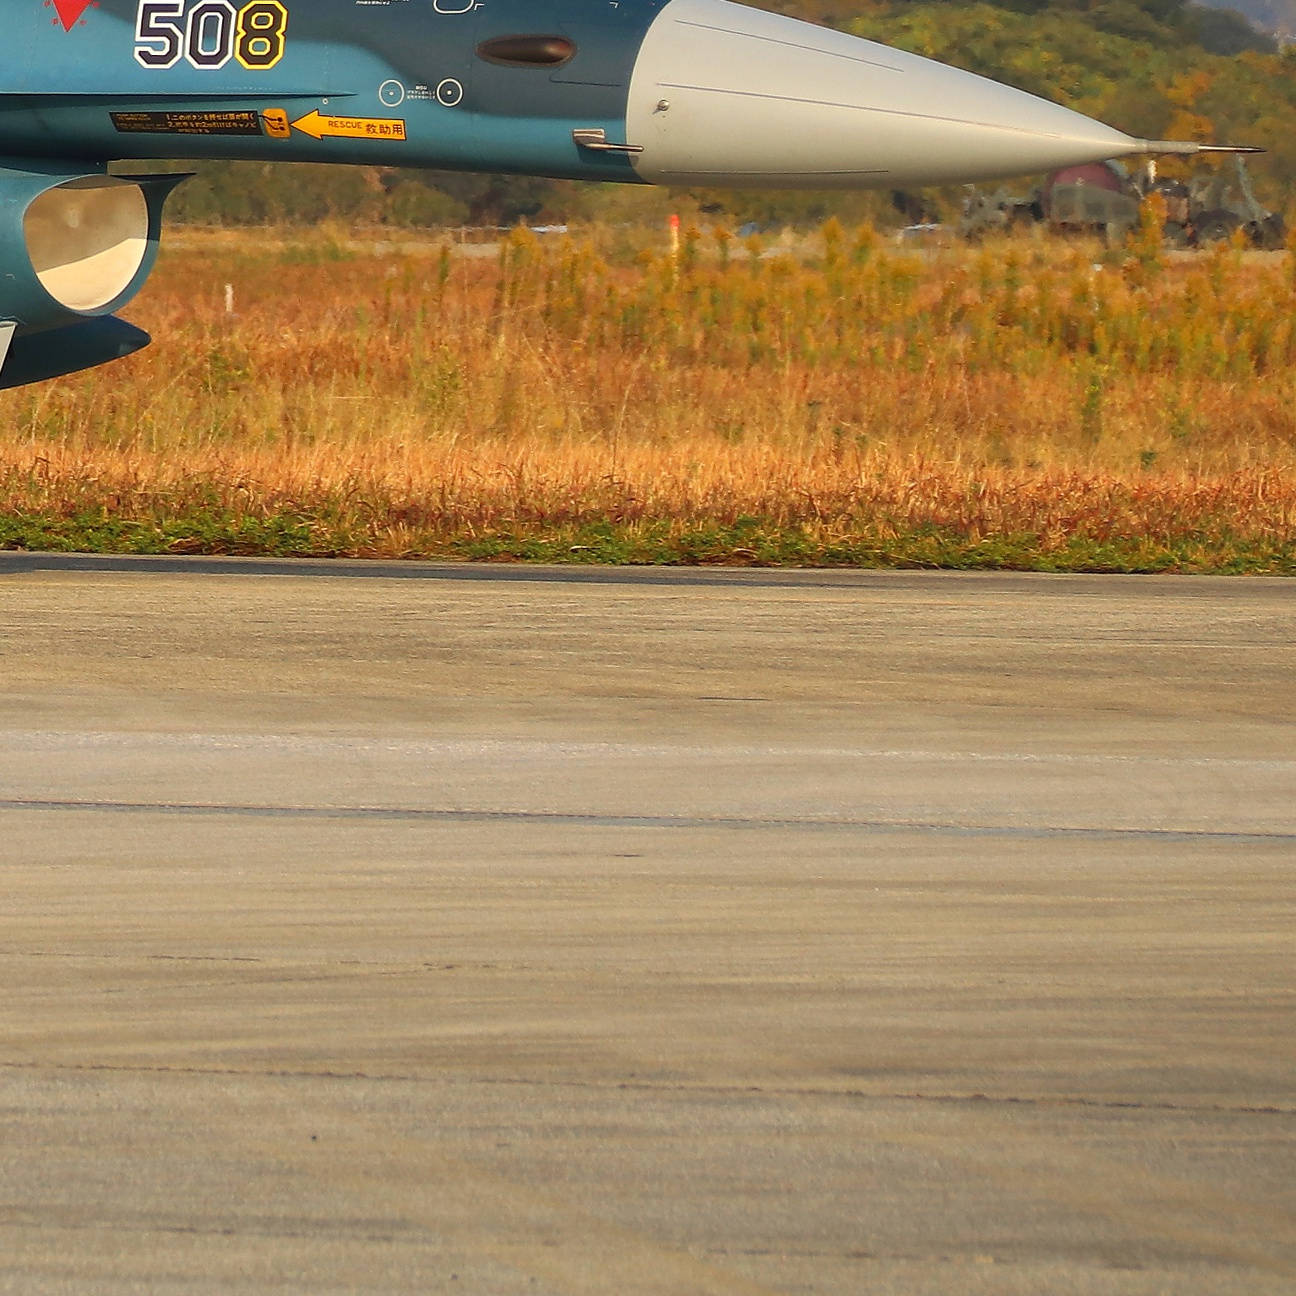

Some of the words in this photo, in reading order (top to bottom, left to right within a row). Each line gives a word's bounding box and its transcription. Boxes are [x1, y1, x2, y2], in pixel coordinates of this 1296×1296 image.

[328, 120, 363, 130] RESCUE
[365, 123, 404, 136] 救助用
